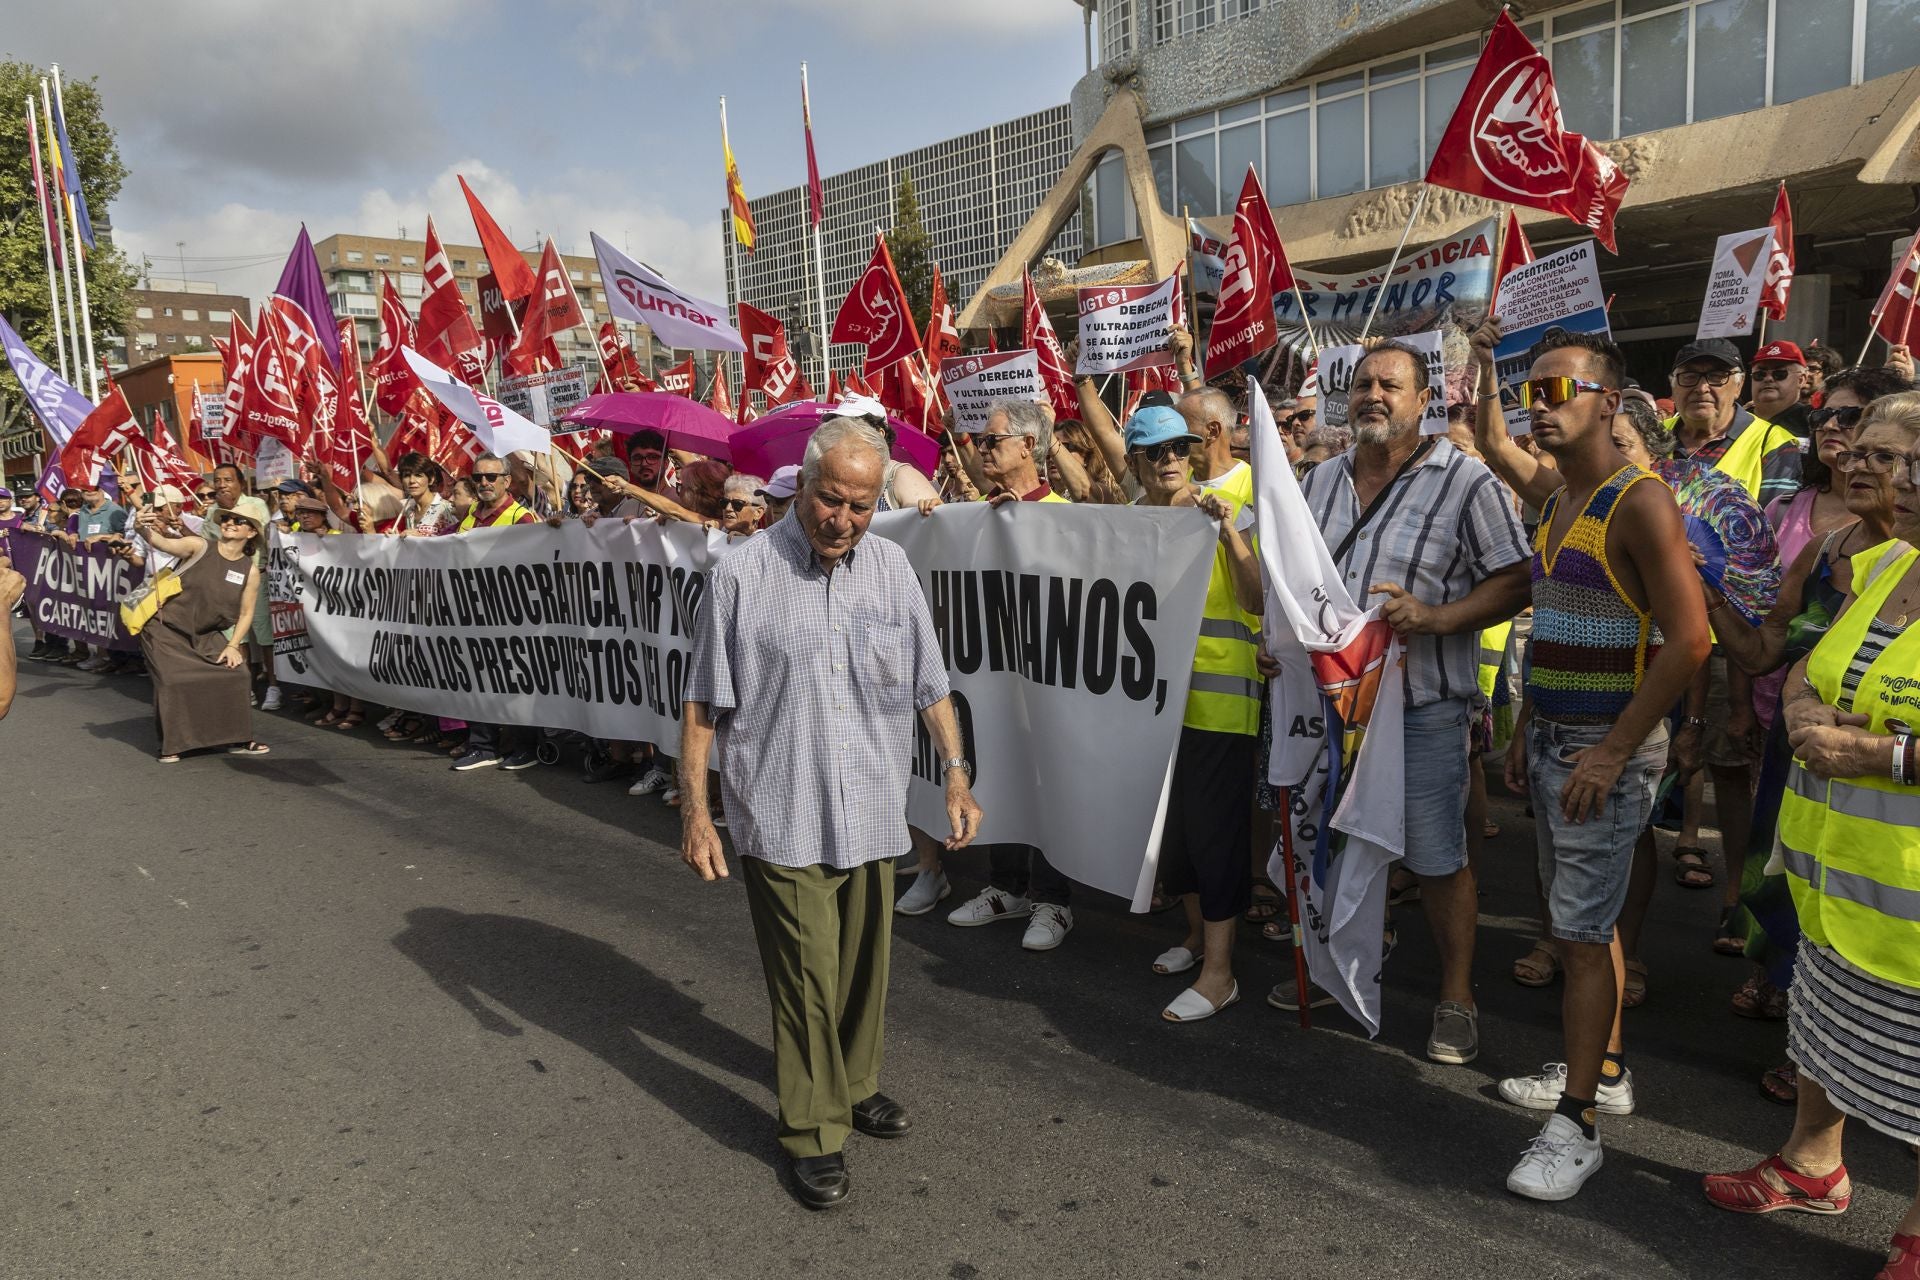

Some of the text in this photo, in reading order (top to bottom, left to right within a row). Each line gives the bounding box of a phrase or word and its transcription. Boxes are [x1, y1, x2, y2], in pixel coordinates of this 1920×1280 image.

[1352, 234, 1490, 288] JUSTICIA
[1500, 248, 1587, 291] CONCENTRACIÓN
[1517, 281, 1525, 290] LA
[1527, 264, 1577, 286] CONVIVENCIA
[1713, 278, 1742, 289] PARTIDO
[1715, 270, 1734, 280] TOMA
[1274, 271, 1456, 317] AR MENOR
[1508, 290, 1547, 308] DERECHOS
[1549, 276, 1589, 294] HUMANOS
[1711, 286, 1749, 298] CONTRA EL
[616, 278, 718, 327] Sumar
[1080, 294, 1104, 315] UGT
[1120, 296, 1168, 315] DERECHA
[1508, 307, 1518, 316] DE
[1519, 303, 1529, 311] LA
[1531, 288, 1582, 308] NATURALEZA
[1517, 300, 1566, 320] CONTRA LOS
[1709, 296, 1745, 308] FASCISMO
[1086, 313, 1167, 331] Y ULTRADERECHA
[1500, 300, 1594, 333] RESUPUESTOS DEL ODIO
[1086, 328, 1169, 346] SE ALÍAN CONTRA
[1087, 343, 1169, 360] LOS MÁS DÉBILES
[377, 369, 409, 386] ugt.es
[943, 364, 964, 382] UGT
[978, 368, 1034, 382] DERECHA
[551, 385, 571, 394] CENTRO
[554, 392, 580, 402] MENORES
[961, 385, 1035, 398] ULTRADERECHA
[1327, 401, 1349, 415] STOP
[313, 566, 345, 615] POR
[344, 568, 365, 618] LA
[448, 550, 626, 634] DEMOCRÁTICA,
[625, 562, 663, 634] POR
[931, 569, 1167, 716] HUMANOS,
[369, 630, 436, 689] CONTRA
[425, 636, 472, 692] LOS
[466, 635, 643, 706] PRESUPUESTOS
[1880, 691, 1889, 702] de
